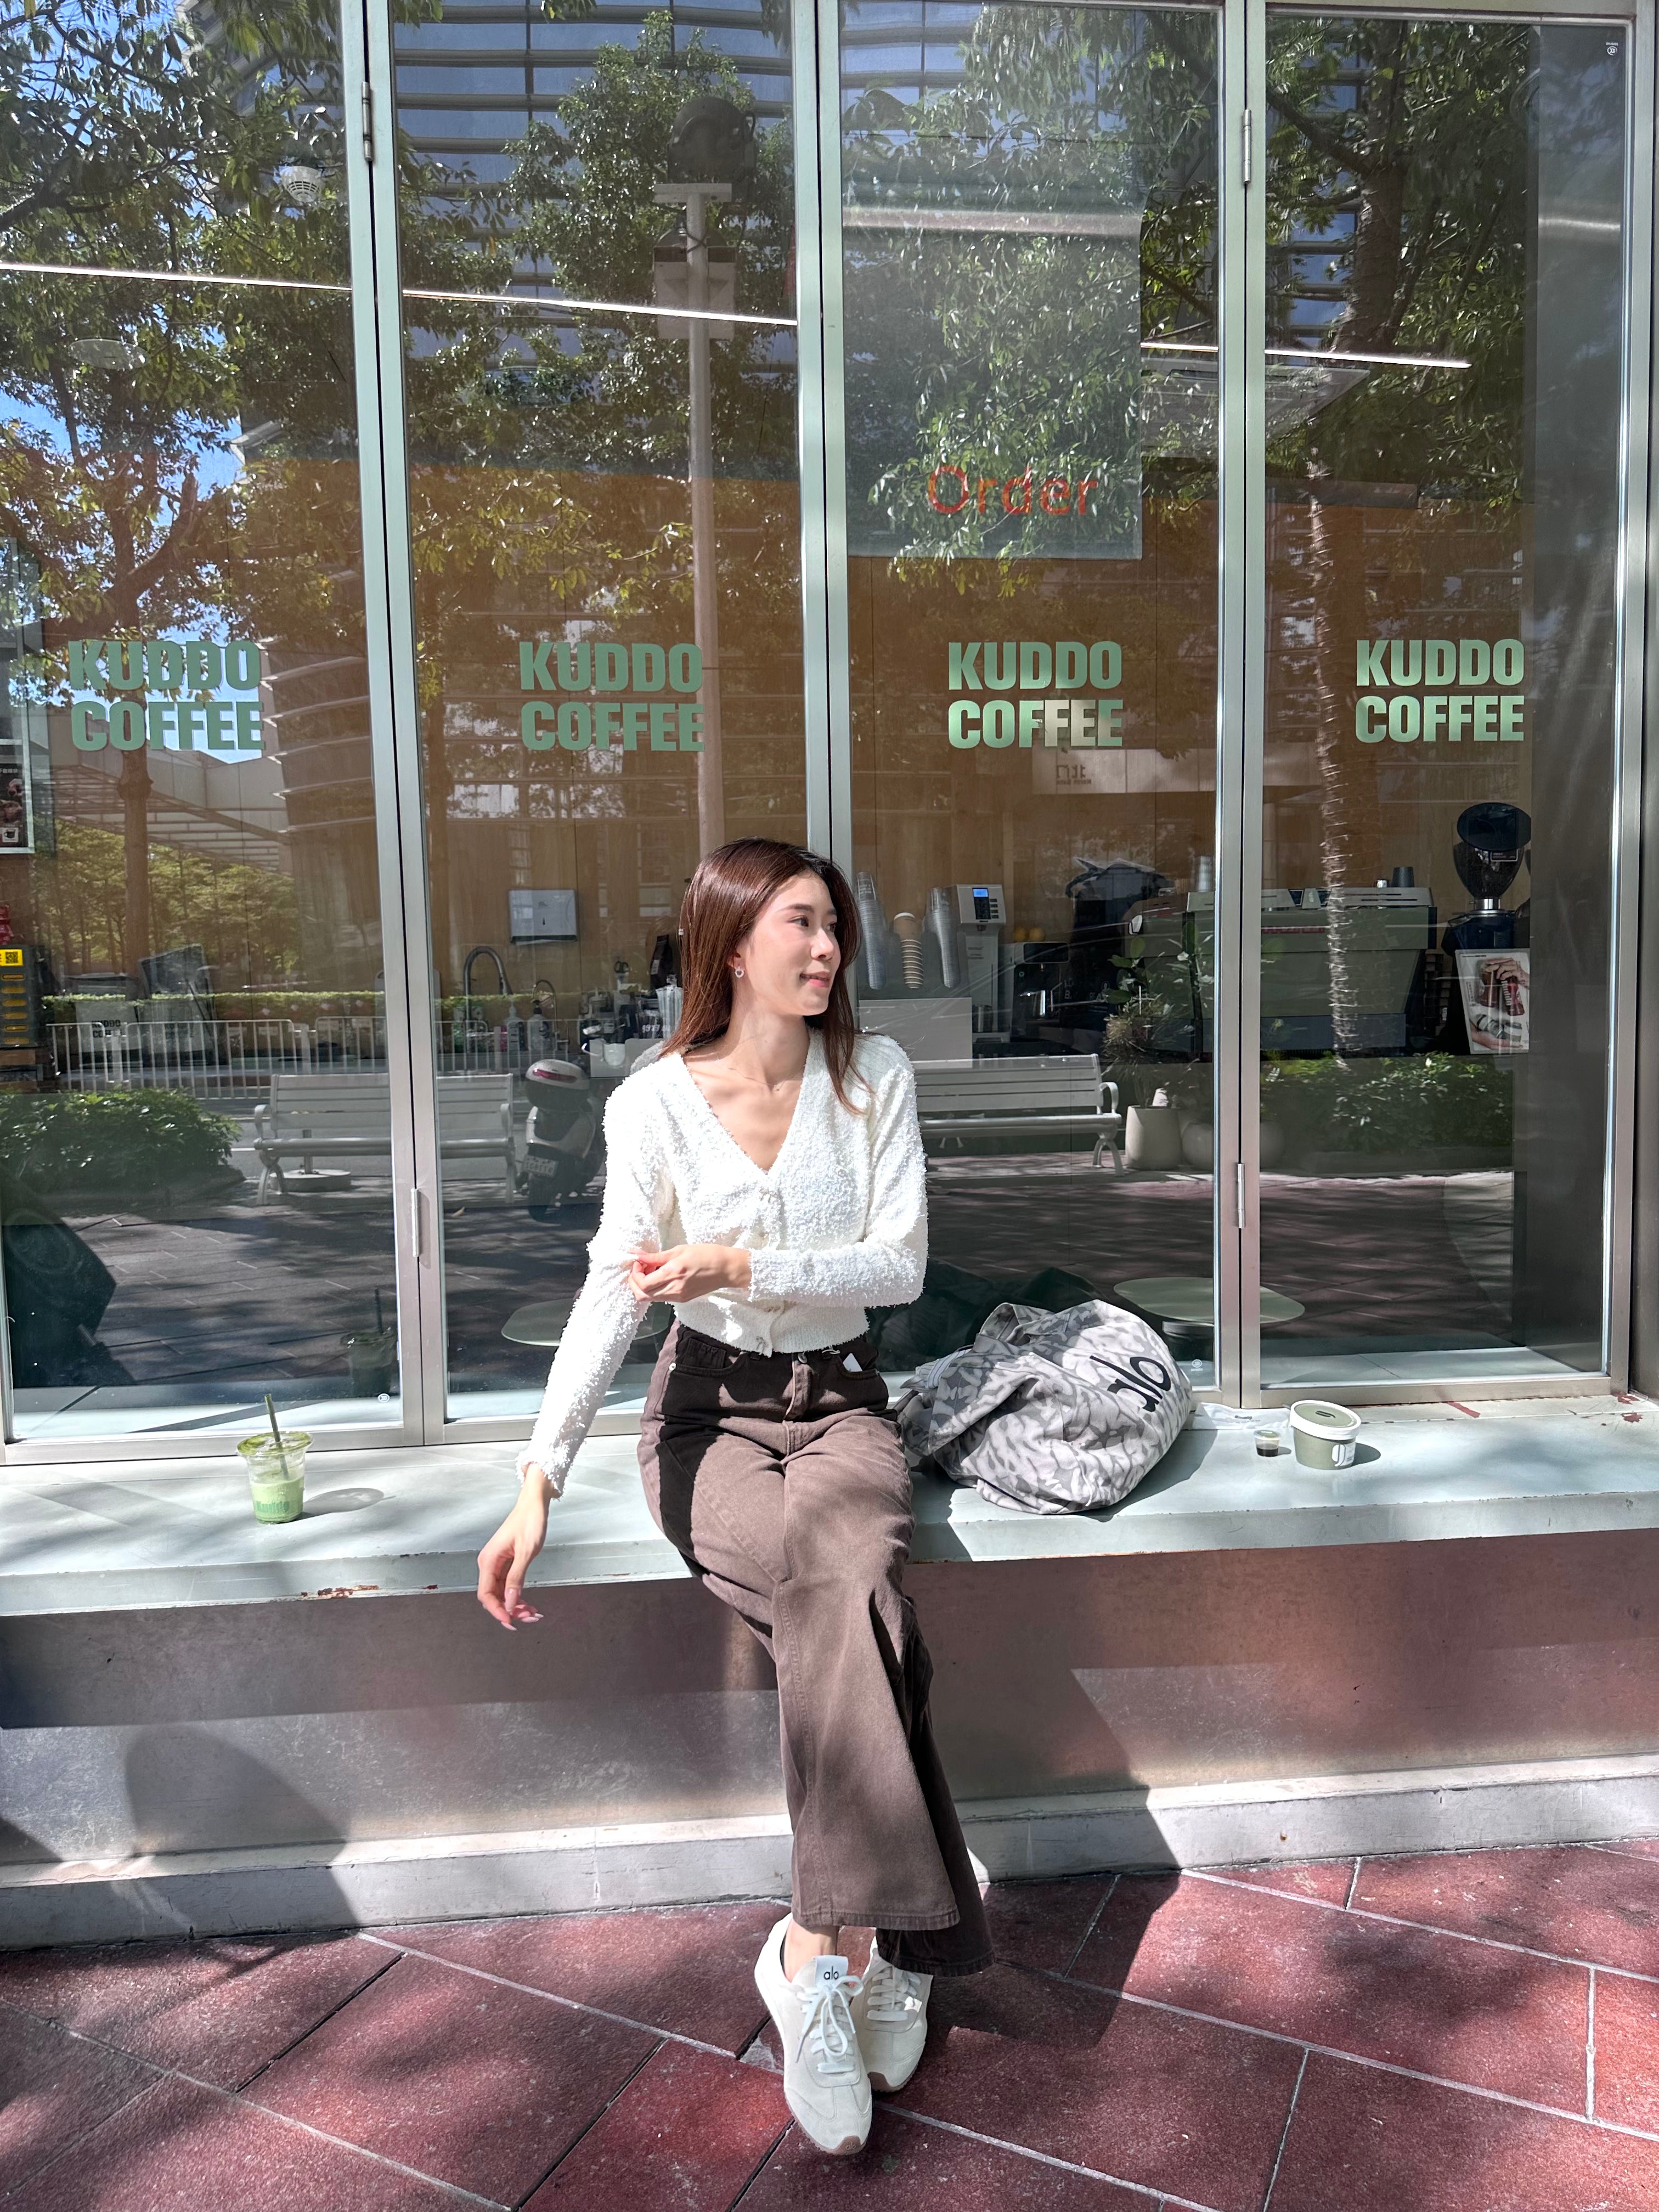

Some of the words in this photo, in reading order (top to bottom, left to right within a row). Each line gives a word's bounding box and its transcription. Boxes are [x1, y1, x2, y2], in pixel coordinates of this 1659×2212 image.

[928, 465, 1098, 515] Order
[68, 641, 261, 690] KUDDO
[519, 642, 703, 692] KUDDO
[949, 641, 1122, 690] KUDDO
[1356, 639, 1525, 686] KUDDO
[71, 701, 266, 751] COFFEE
[521, 701, 705, 752] COFFEE
[948, 699, 1124, 749] COFFEE
[1355, 695, 1525, 743] COFFEE
[1090, 1355, 1171, 1412] alo
[823, 1966, 839, 1980] alo
